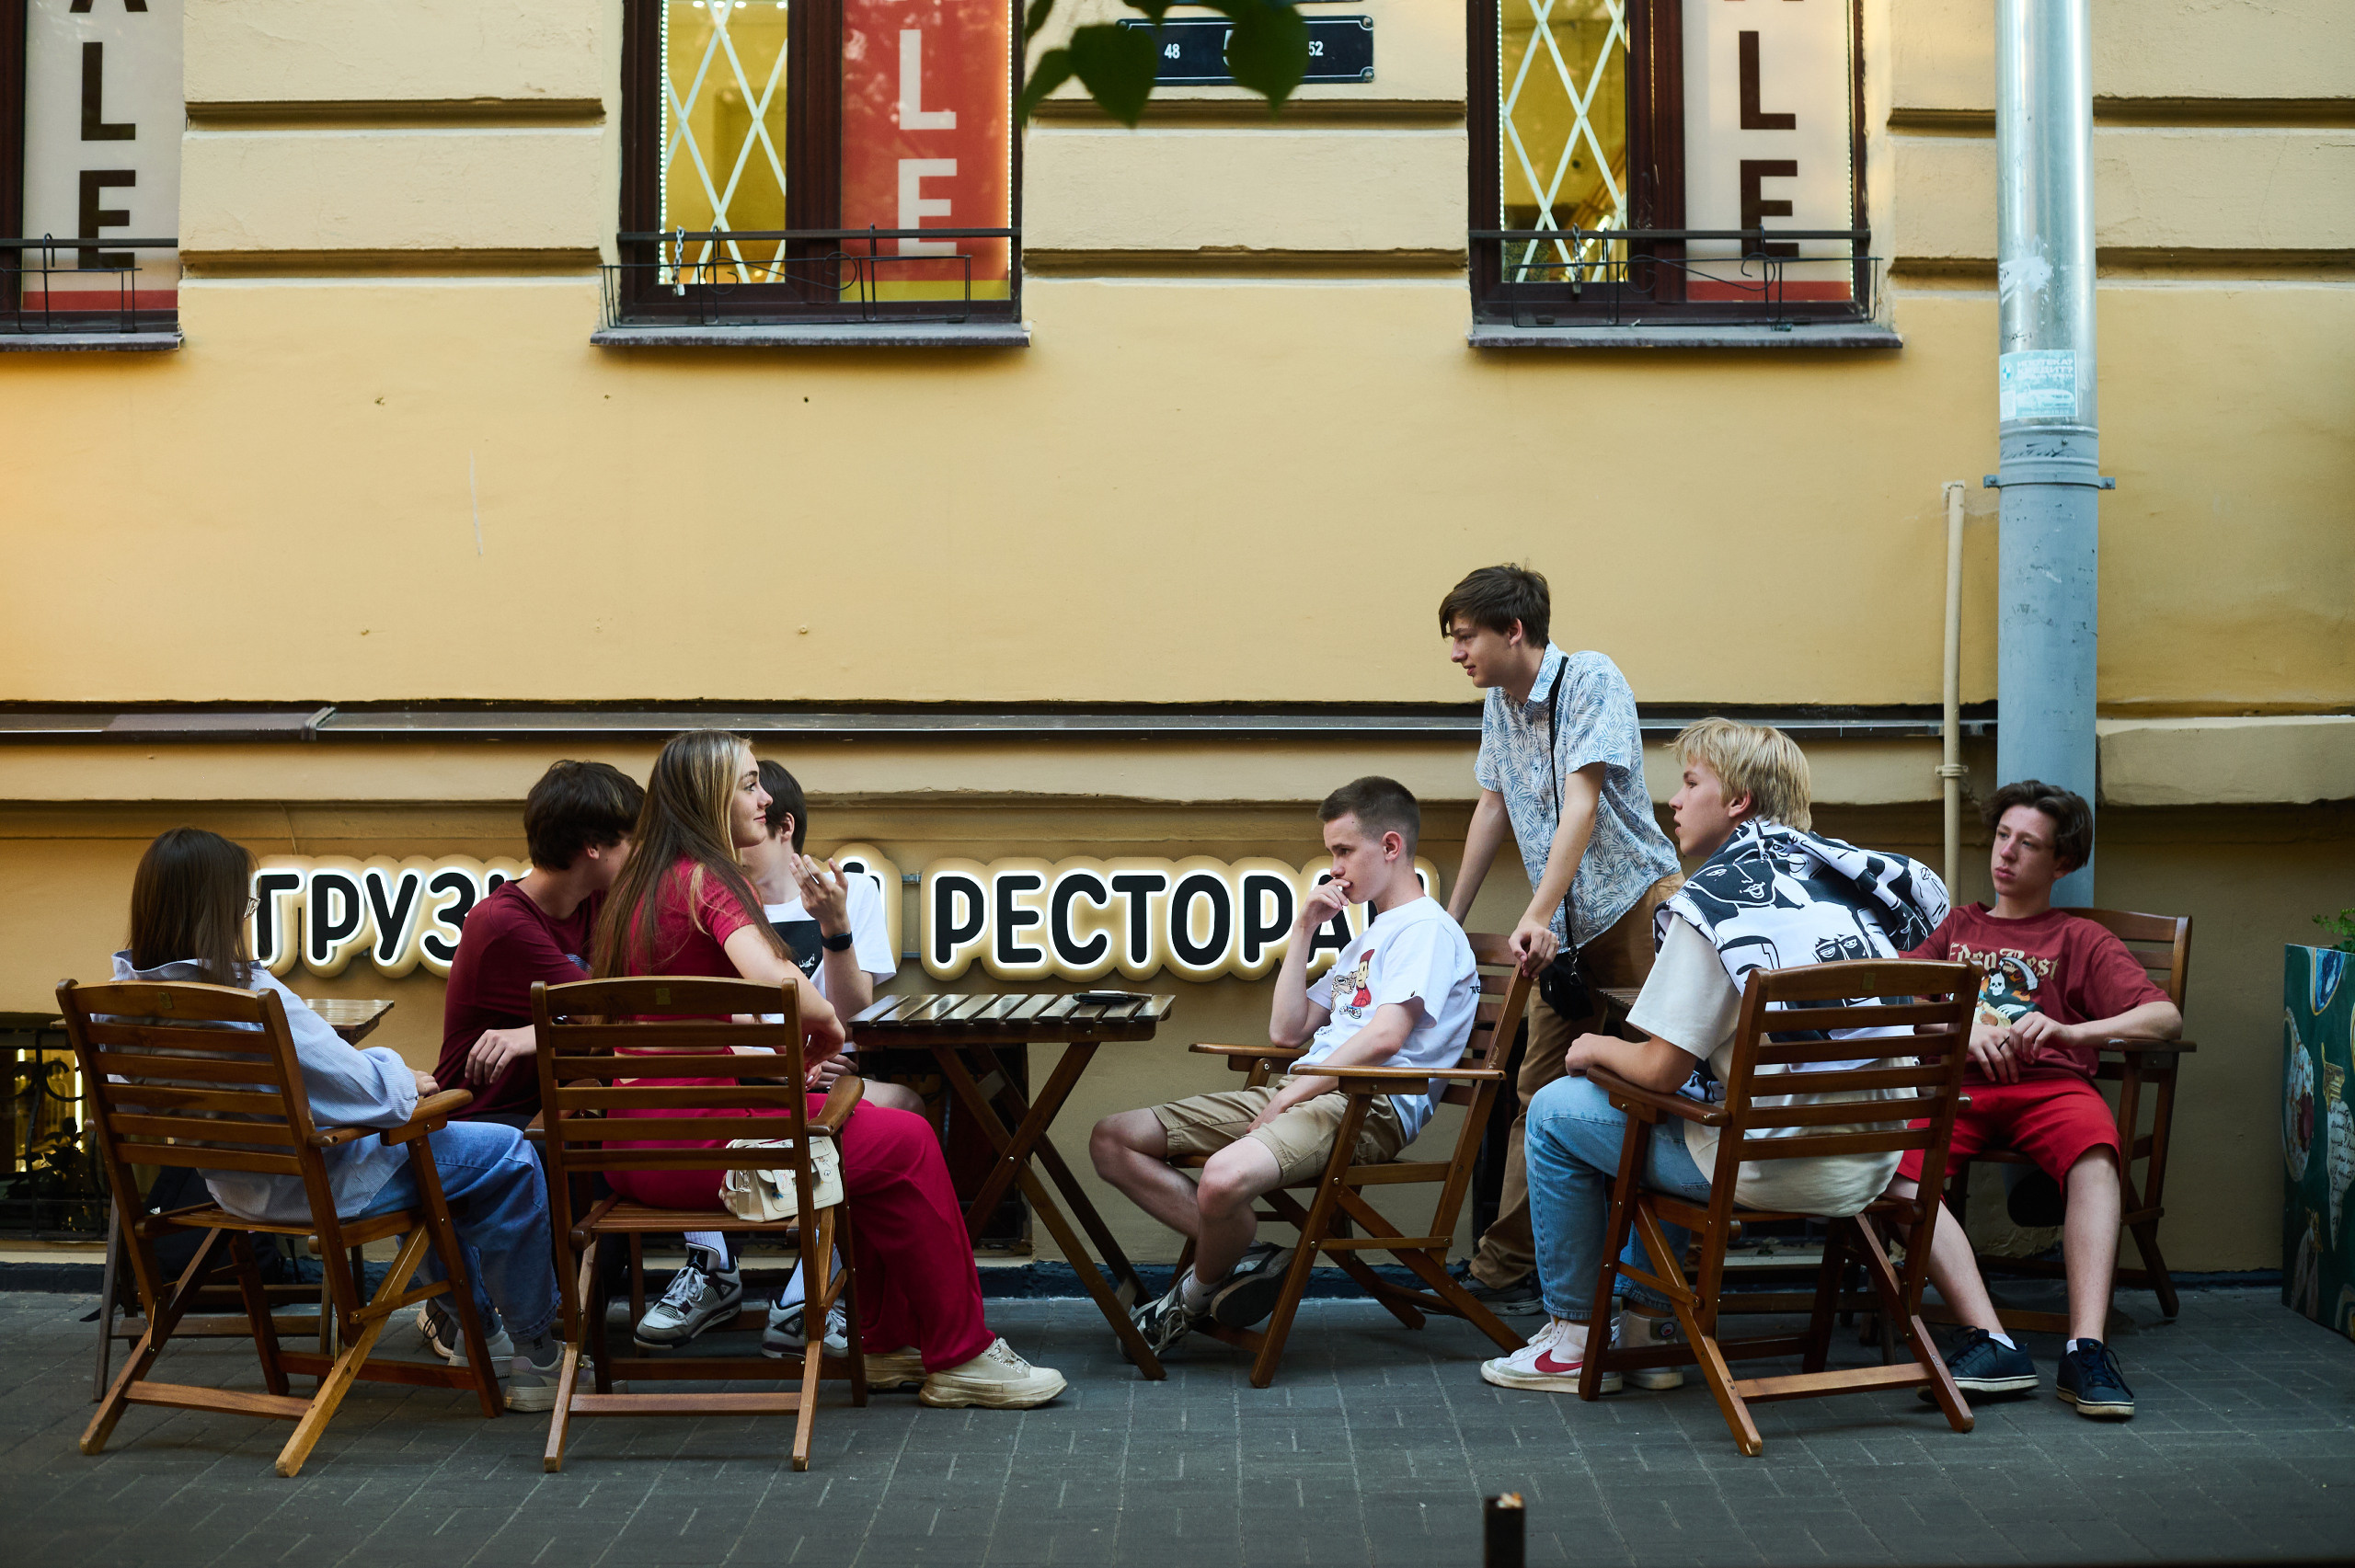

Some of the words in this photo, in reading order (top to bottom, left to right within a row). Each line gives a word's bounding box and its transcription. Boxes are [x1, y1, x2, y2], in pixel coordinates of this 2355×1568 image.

[1164, 43, 1180, 59] 48
[1308, 40, 1324, 56] 52
[70, 0, 148, 269] LE
[935, 874, 1425, 966] РЕСТОРА
